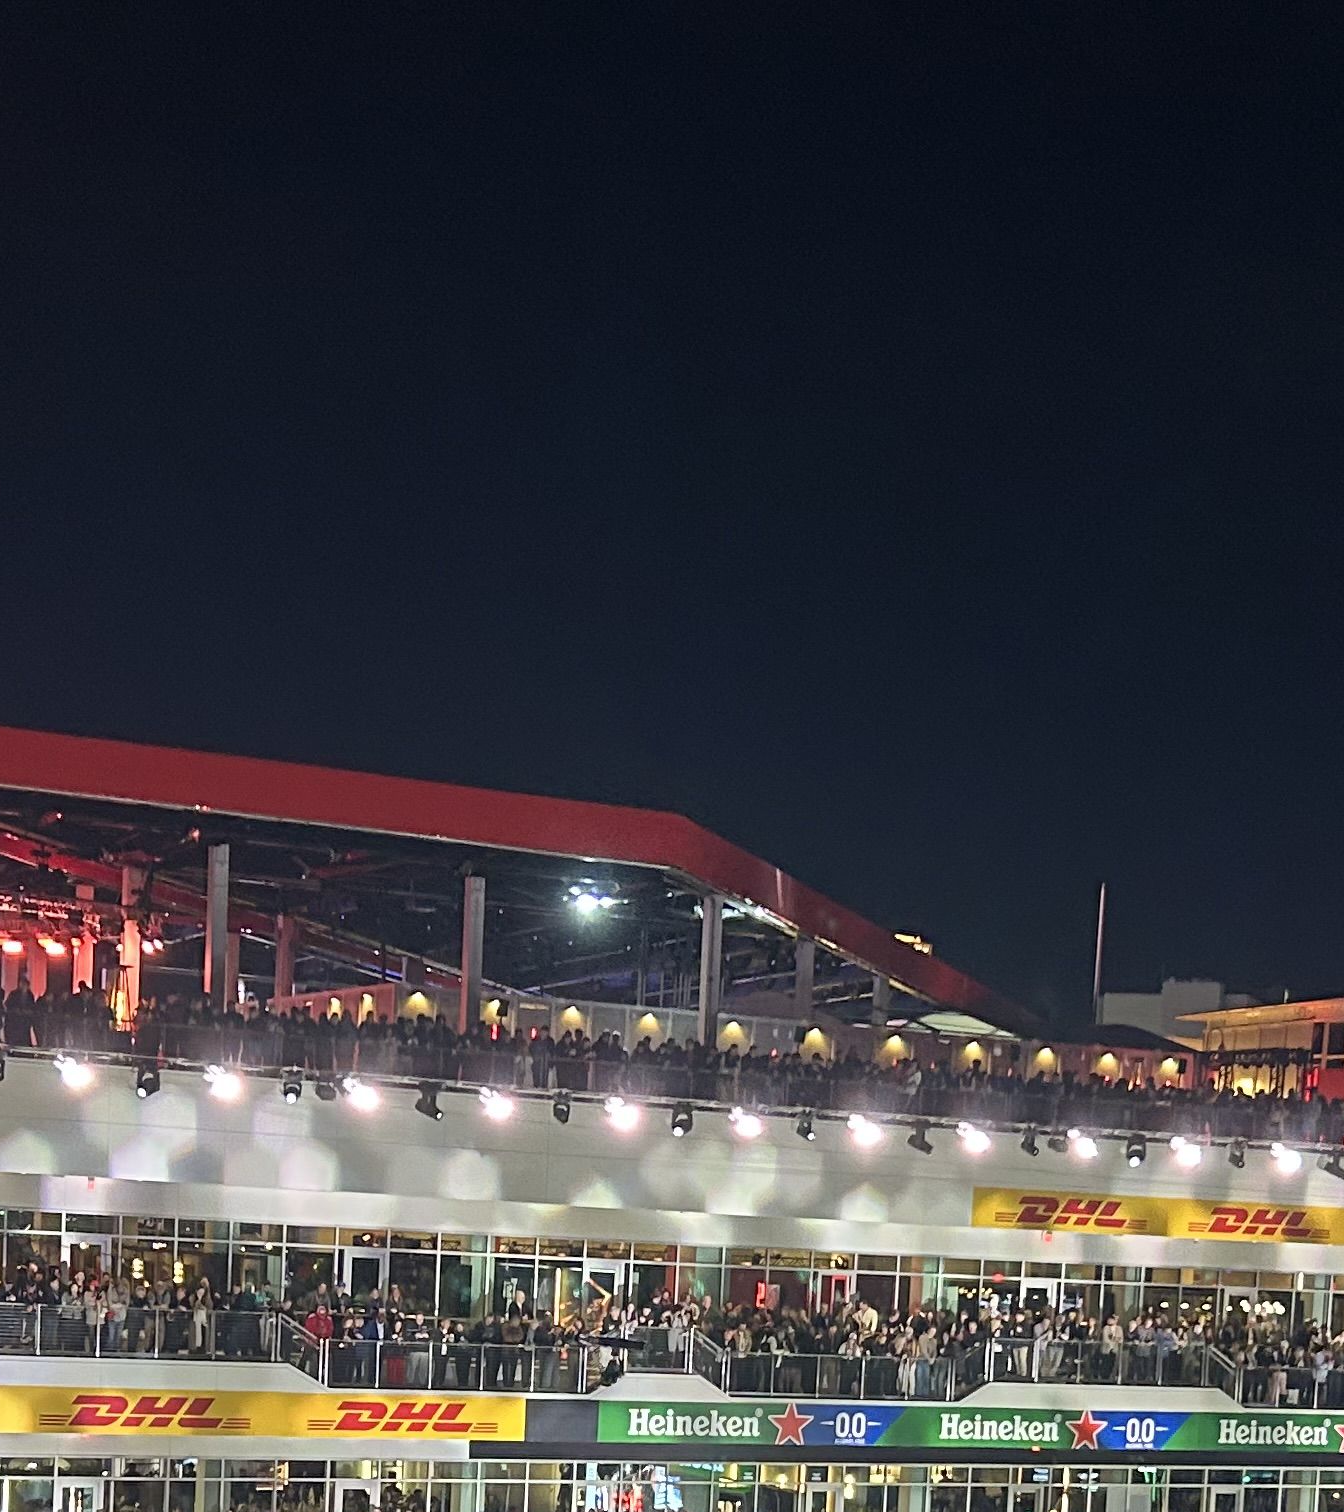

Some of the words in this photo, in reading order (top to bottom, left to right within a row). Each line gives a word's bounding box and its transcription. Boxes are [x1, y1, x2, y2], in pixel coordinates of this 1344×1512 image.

[1008, 1196, 1127, 1228] DHL
[1208, 1207, 1312, 1238] DHL
[69, 1395, 222, 1429] DHL
[334, 1401, 472, 1433] DHL
[628, 1407, 760, 1438] Heineken
[835, 1412, 866, 1438] 0.0
[938, 1414, 1060, 1442] Heineken
[1126, 1418, 1154, 1443] 0.0
[1218, 1419, 1330, 1446] Heineken
